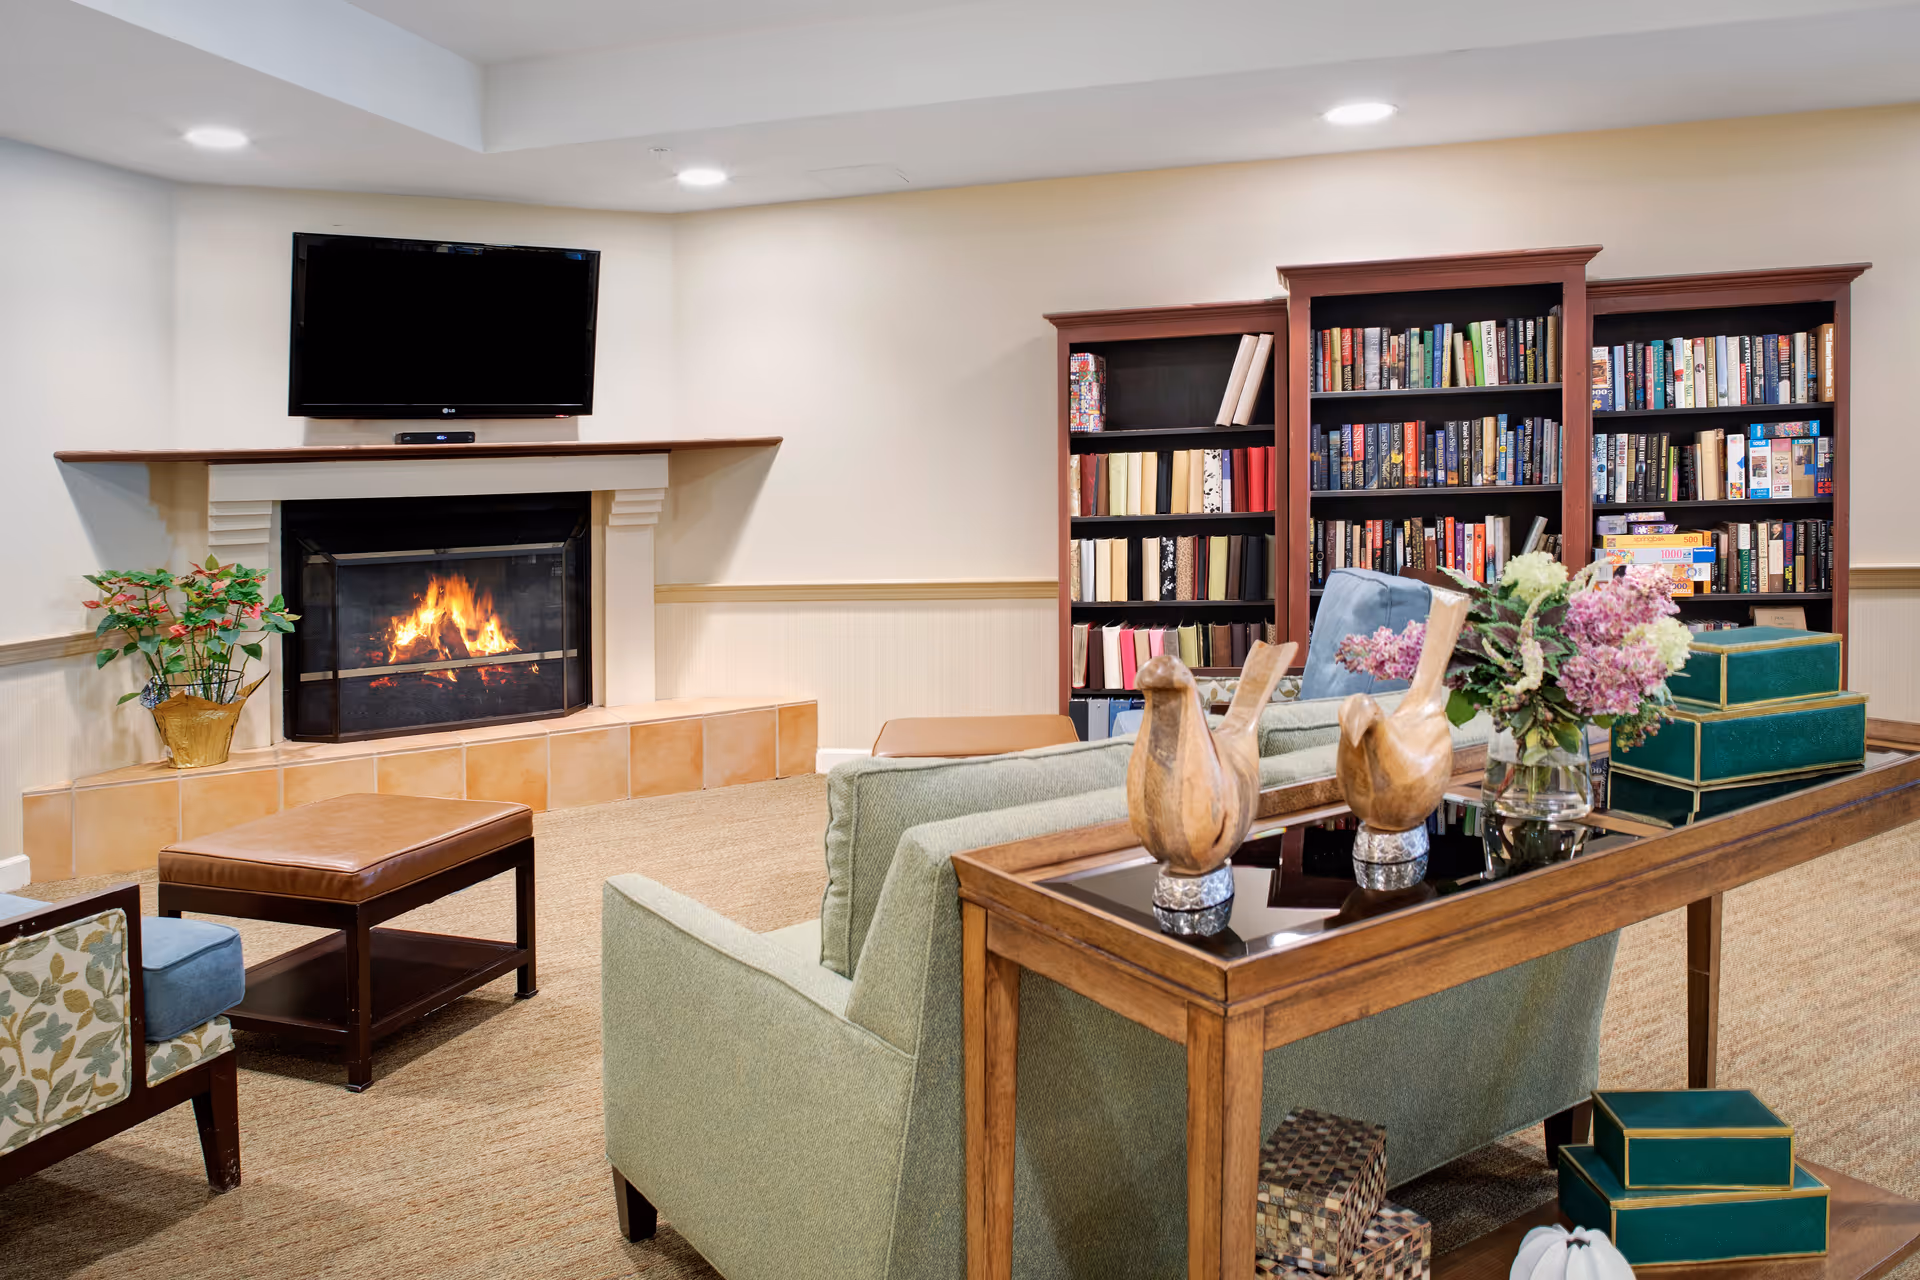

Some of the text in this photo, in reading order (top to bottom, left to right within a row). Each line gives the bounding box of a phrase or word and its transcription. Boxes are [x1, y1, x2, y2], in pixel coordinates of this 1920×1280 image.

[1342, 335, 1352, 355] Silva
[1341, 430, 1352, 452] Silva
[1354, 430, 1363, 451] Silva
[1393, 424, 1402, 454] Daniel Silva
[1462, 438, 1470, 451] Silva
[1523, 420, 1533, 461] JOHN SANDFORD
[1381, 443, 1389, 456] Silva
[1819, 523, 1827, 537] Lucky
[1661, 549, 1682, 559] 1000
[1785, 541, 1793, 565] BALDACCI
